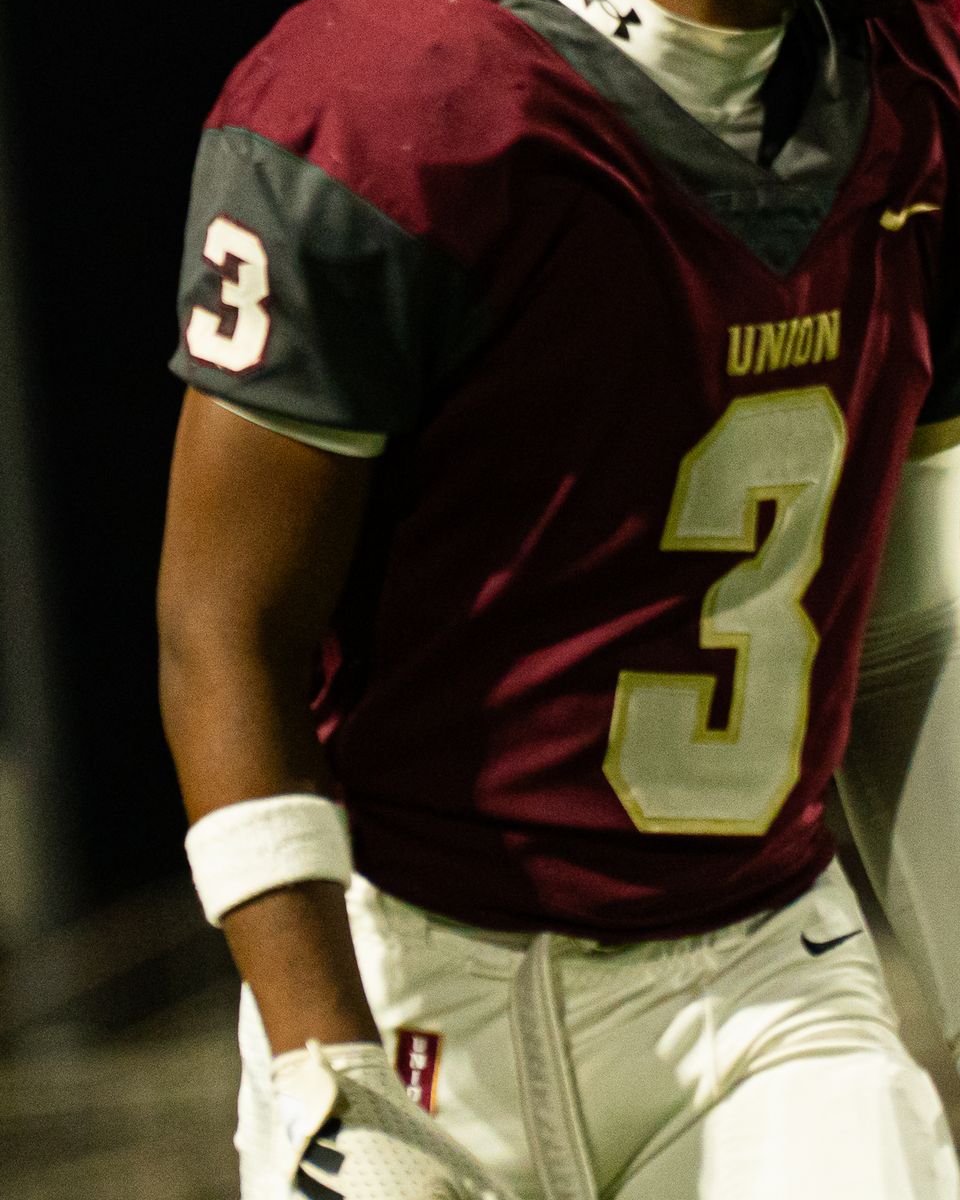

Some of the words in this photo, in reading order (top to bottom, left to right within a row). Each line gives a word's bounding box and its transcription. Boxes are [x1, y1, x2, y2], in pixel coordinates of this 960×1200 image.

[185, 213, 271, 376] 3
[726, 308, 842, 377] UNION
[602, 385, 849, 837] 3
